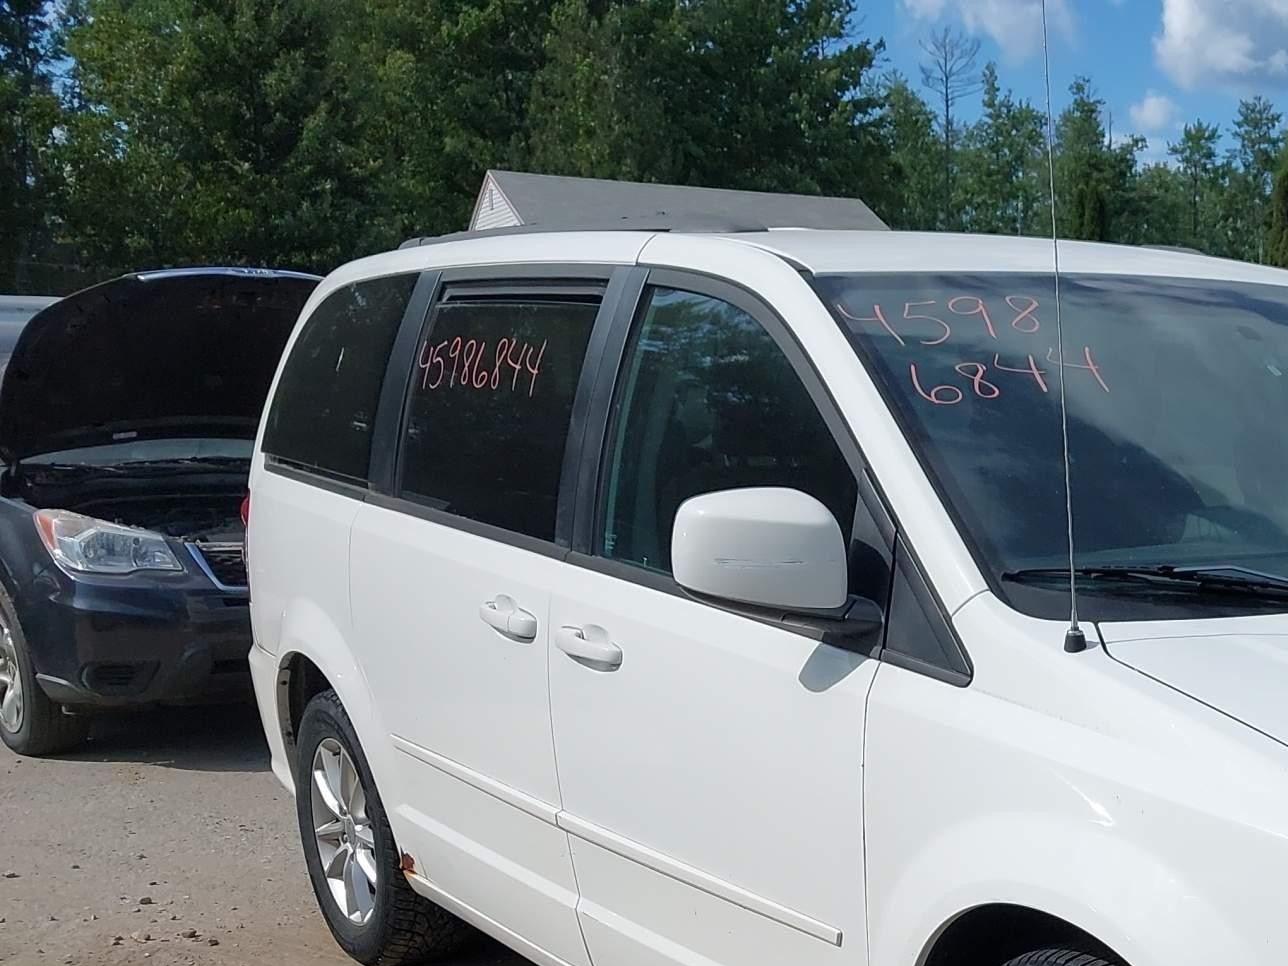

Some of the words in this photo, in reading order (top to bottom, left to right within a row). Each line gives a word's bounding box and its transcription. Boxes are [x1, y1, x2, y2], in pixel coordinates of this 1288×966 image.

[836, 295, 1041, 346] 4598
[418, 336, 548, 398] 45986844
[910, 345, 1110, 405] 6844
